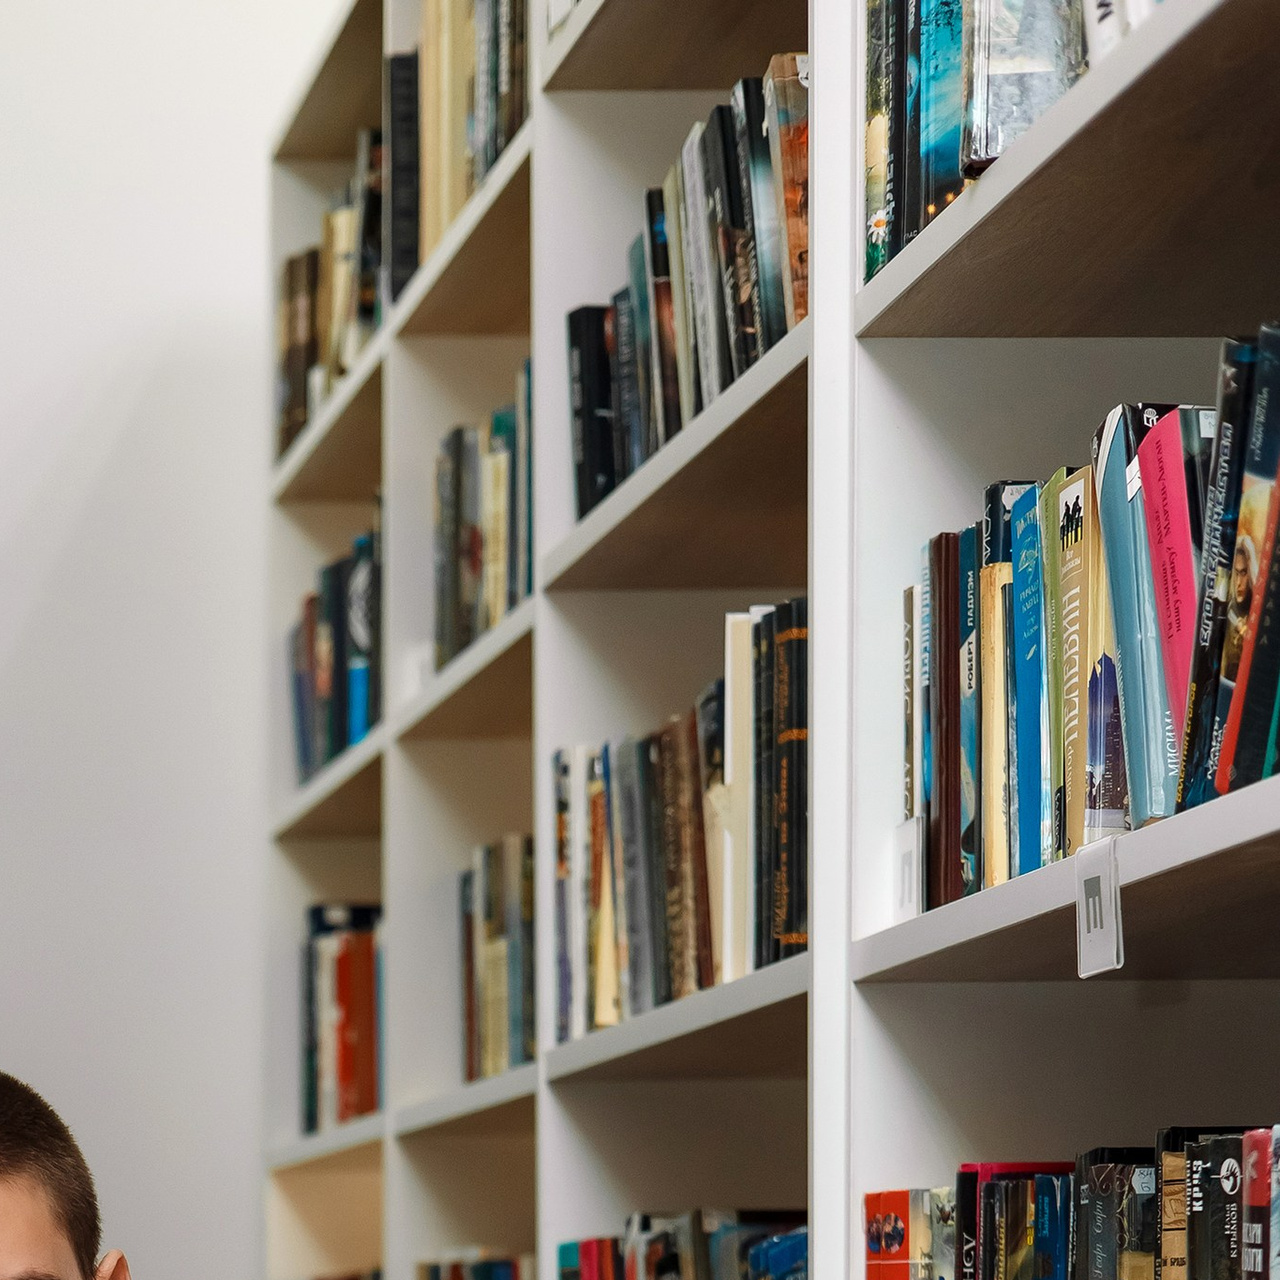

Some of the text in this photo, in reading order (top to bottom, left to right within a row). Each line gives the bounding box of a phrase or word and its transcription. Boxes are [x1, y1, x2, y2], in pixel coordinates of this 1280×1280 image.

[966, 570, 974, 691] РОБЕРТ ЛАДЛЭМ
[1062, 585, 1080, 746] ПЕЛЕВИН
[1230, 1202, 1238, 1258] КРЫМОВ
